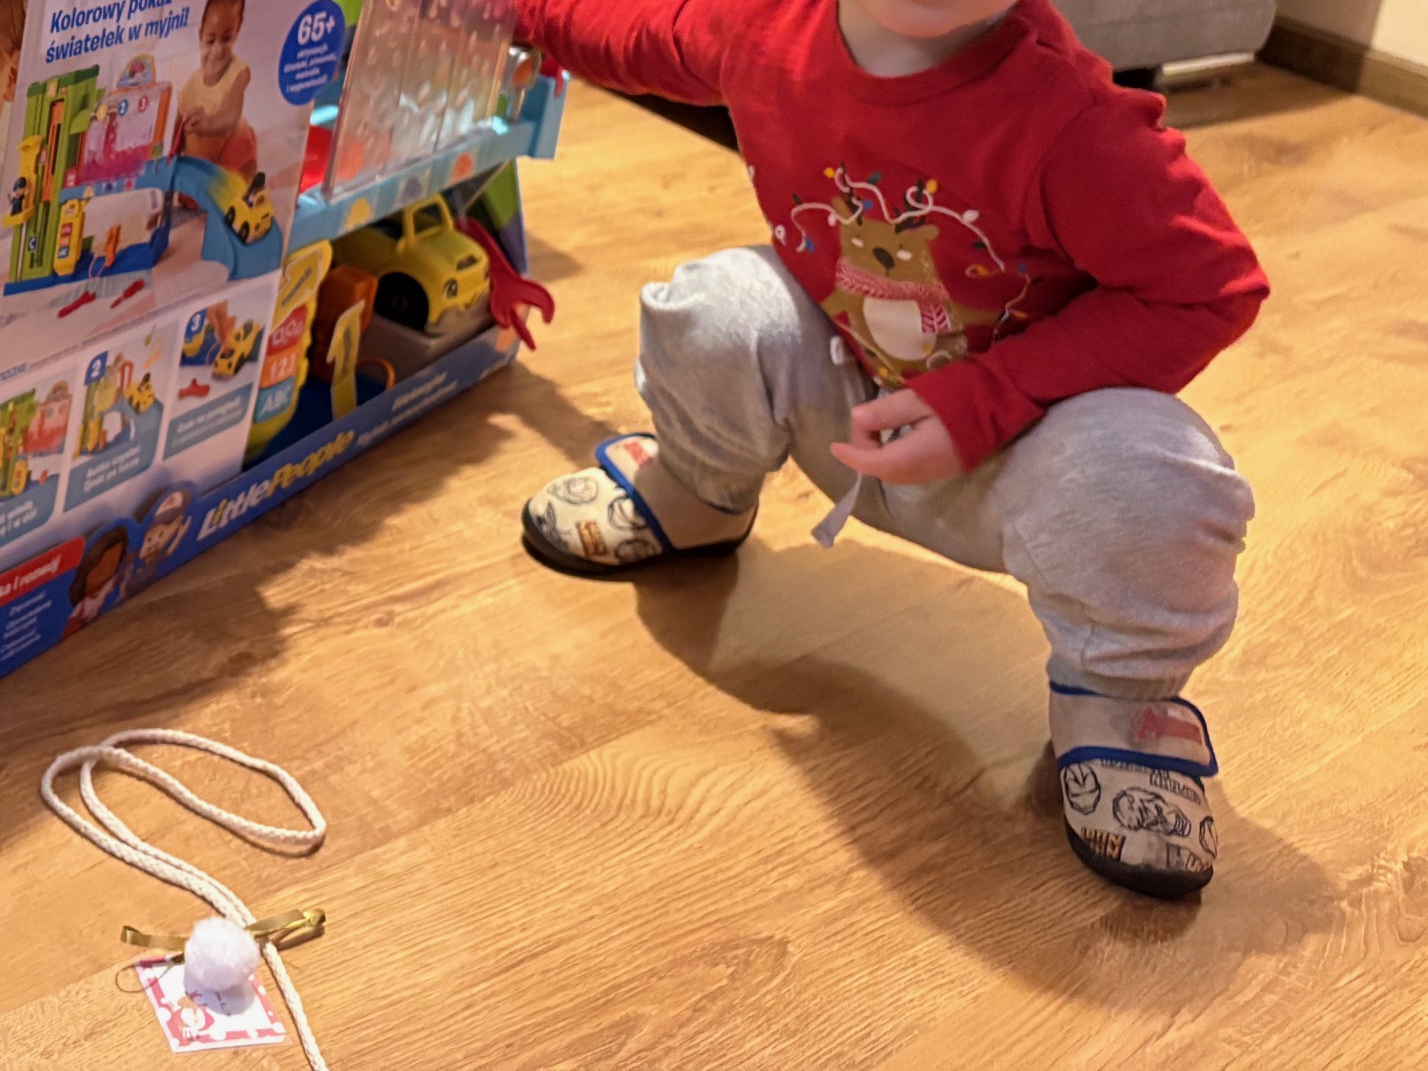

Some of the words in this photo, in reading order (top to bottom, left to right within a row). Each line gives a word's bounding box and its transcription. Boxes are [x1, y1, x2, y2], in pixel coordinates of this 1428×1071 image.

[45, 25, 124, 64] światełek
[128, 25, 143, 42] w
[144, 7, 190, 39] myjni!
[297, 11, 335, 45] 65+
[191, 314, 201, 330] 3
[91, 359, 101, 377] 2
